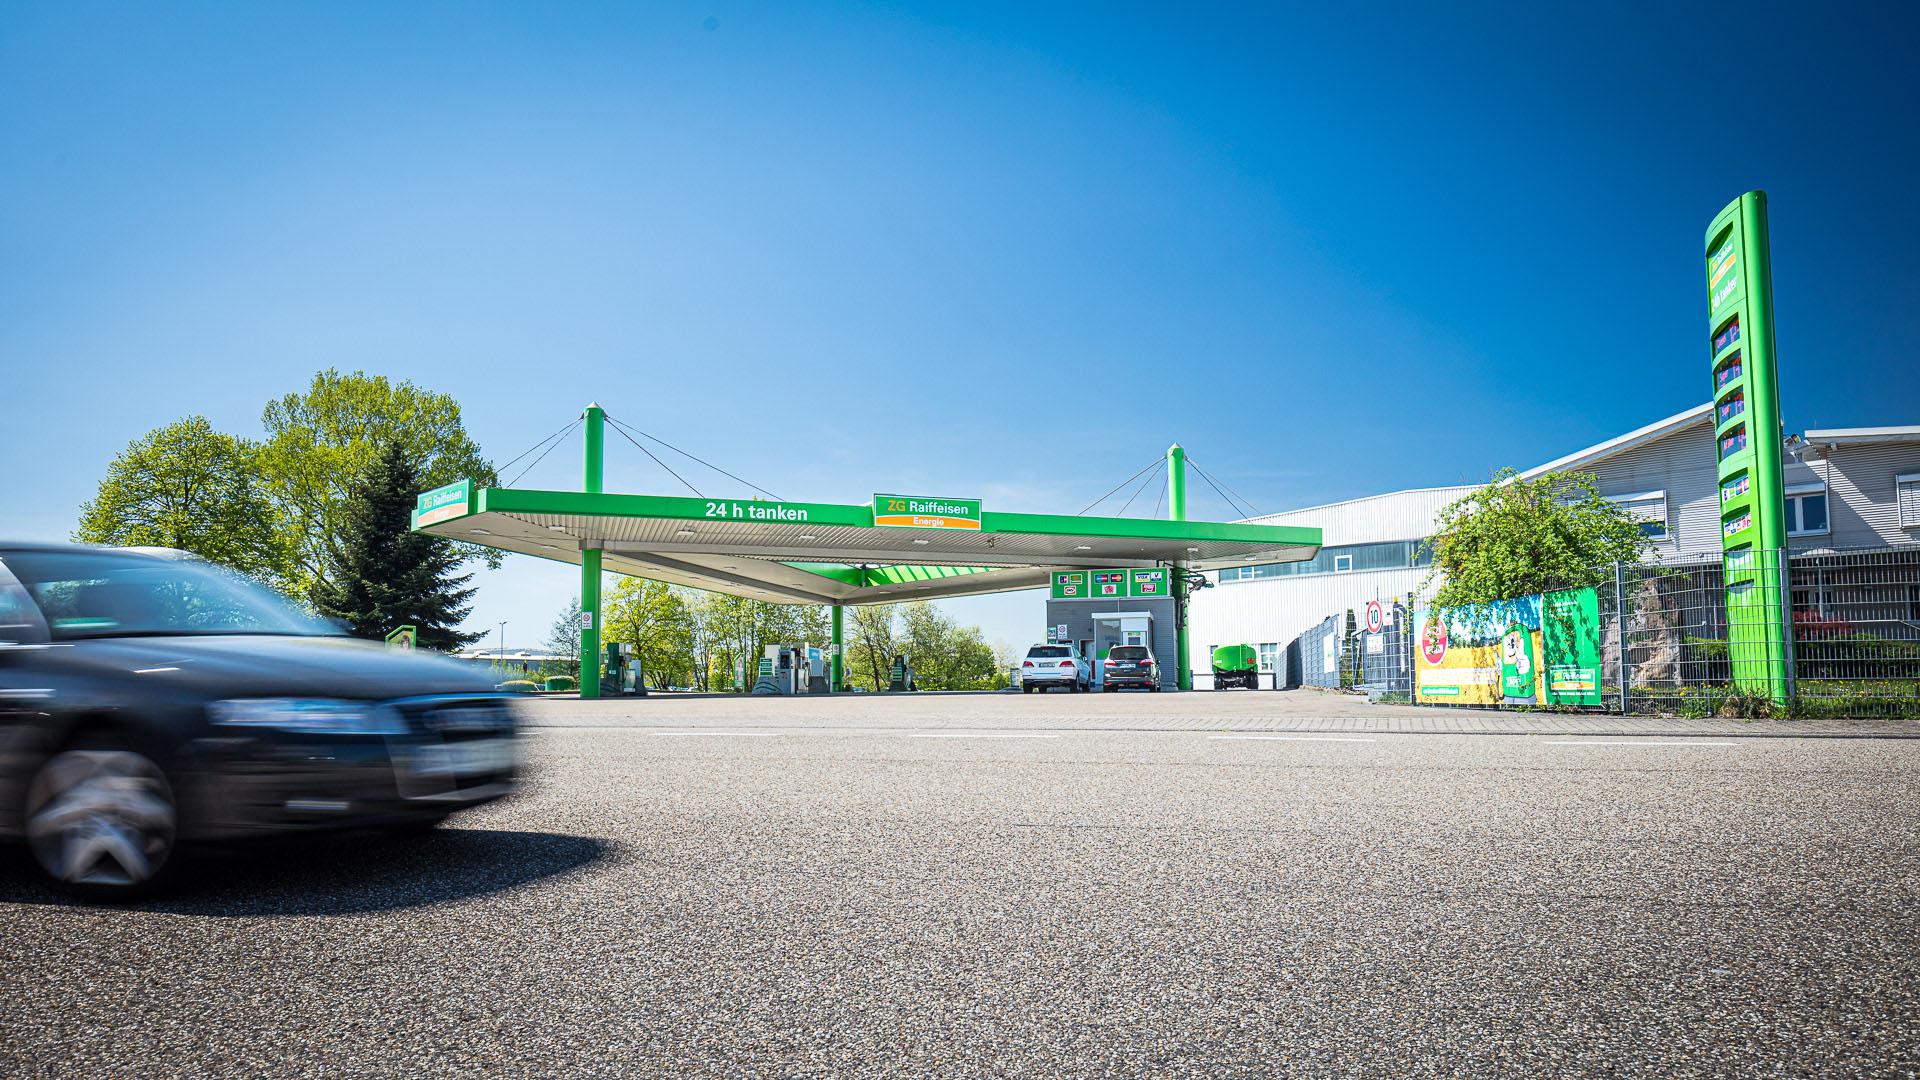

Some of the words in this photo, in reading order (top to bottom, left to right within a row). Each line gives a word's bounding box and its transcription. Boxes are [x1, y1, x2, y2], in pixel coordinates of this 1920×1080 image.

[705, 502, 727, 517] 24
[732, 503, 743, 518] h
[748, 505, 808, 521] tanken
[887, 500, 906, 512] ZG
[909, 501, 969, 515] Raiffeisen
[913, 516, 945, 527] Energie
[1370, 609, 1379, 624] 10
